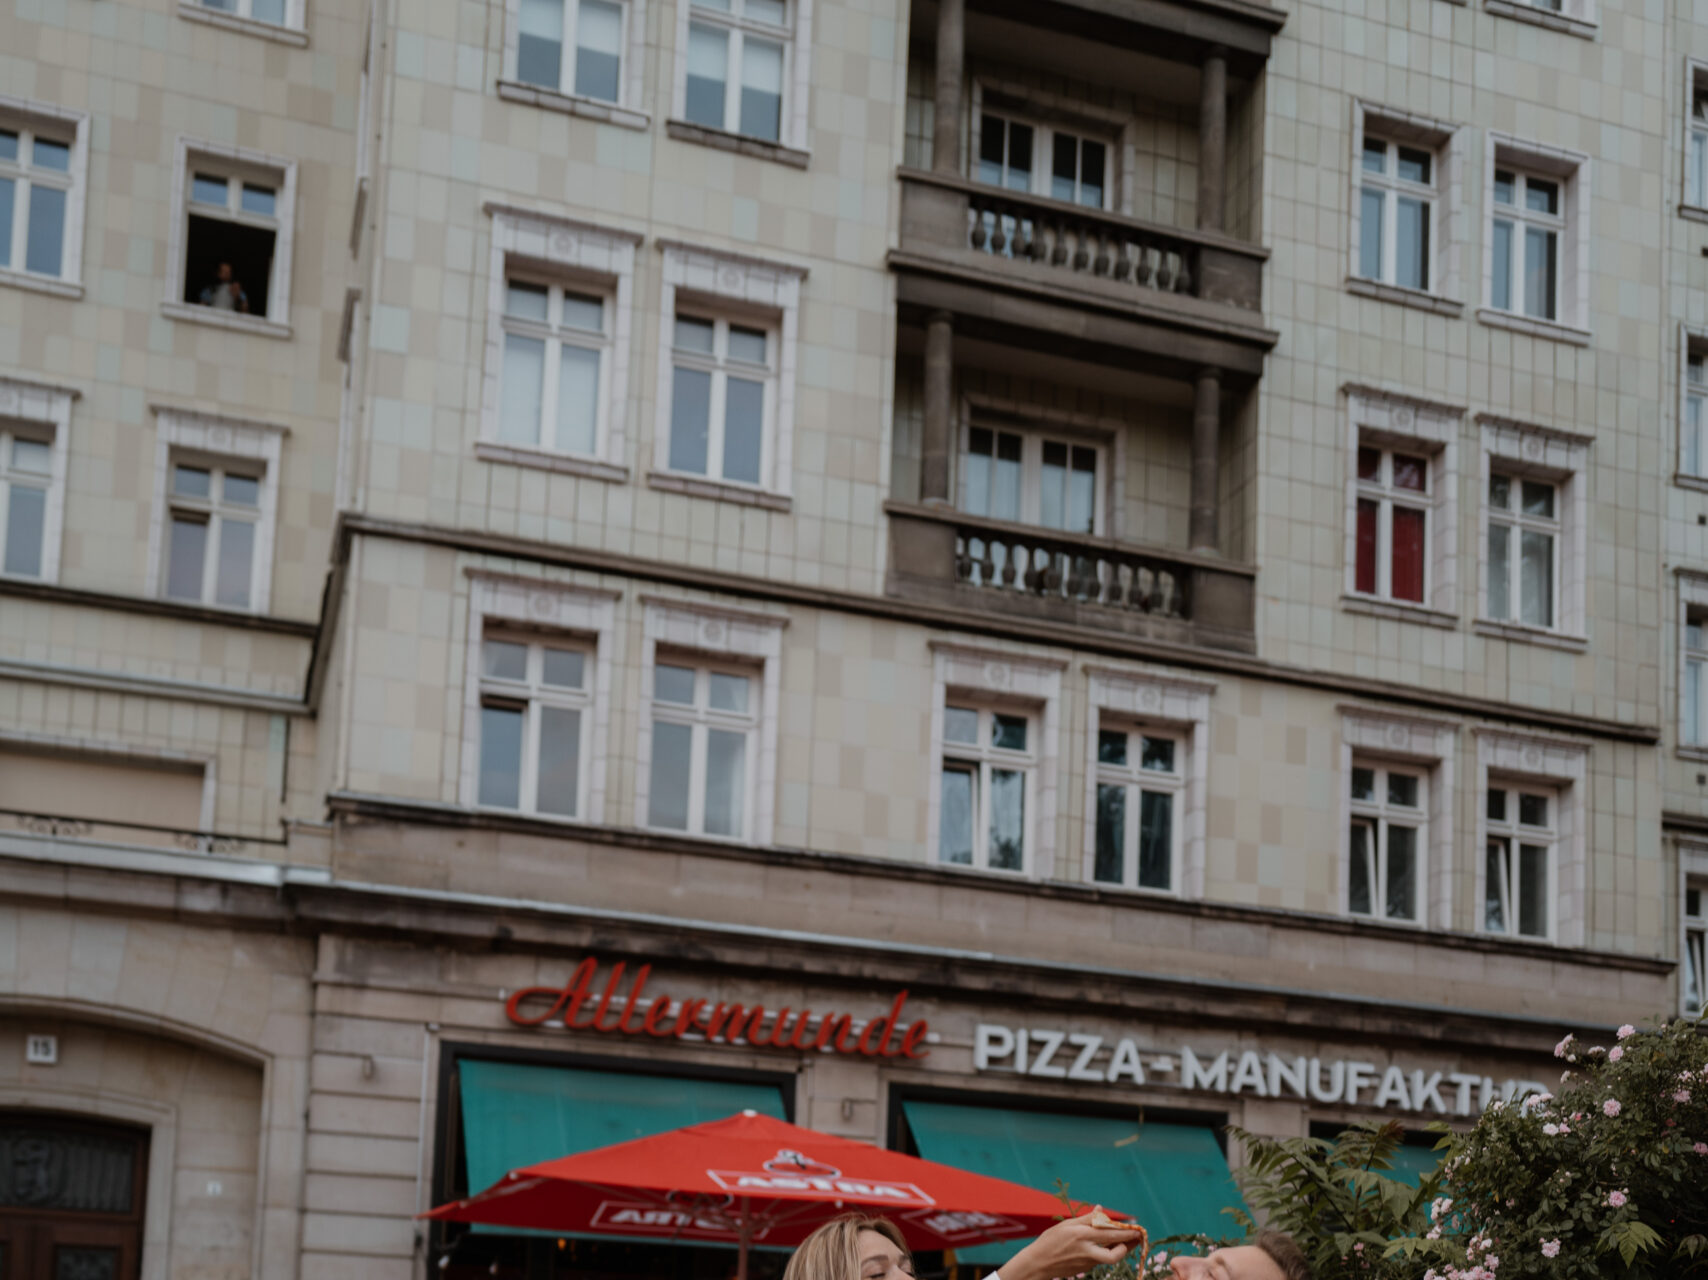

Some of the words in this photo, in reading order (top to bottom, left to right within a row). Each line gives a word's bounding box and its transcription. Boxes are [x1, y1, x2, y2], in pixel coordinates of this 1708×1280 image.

[506, 956, 930, 1059] Allermunde
[33, 1039, 51, 1057] 15
[737, 1176, 911, 1199] ASTRA
